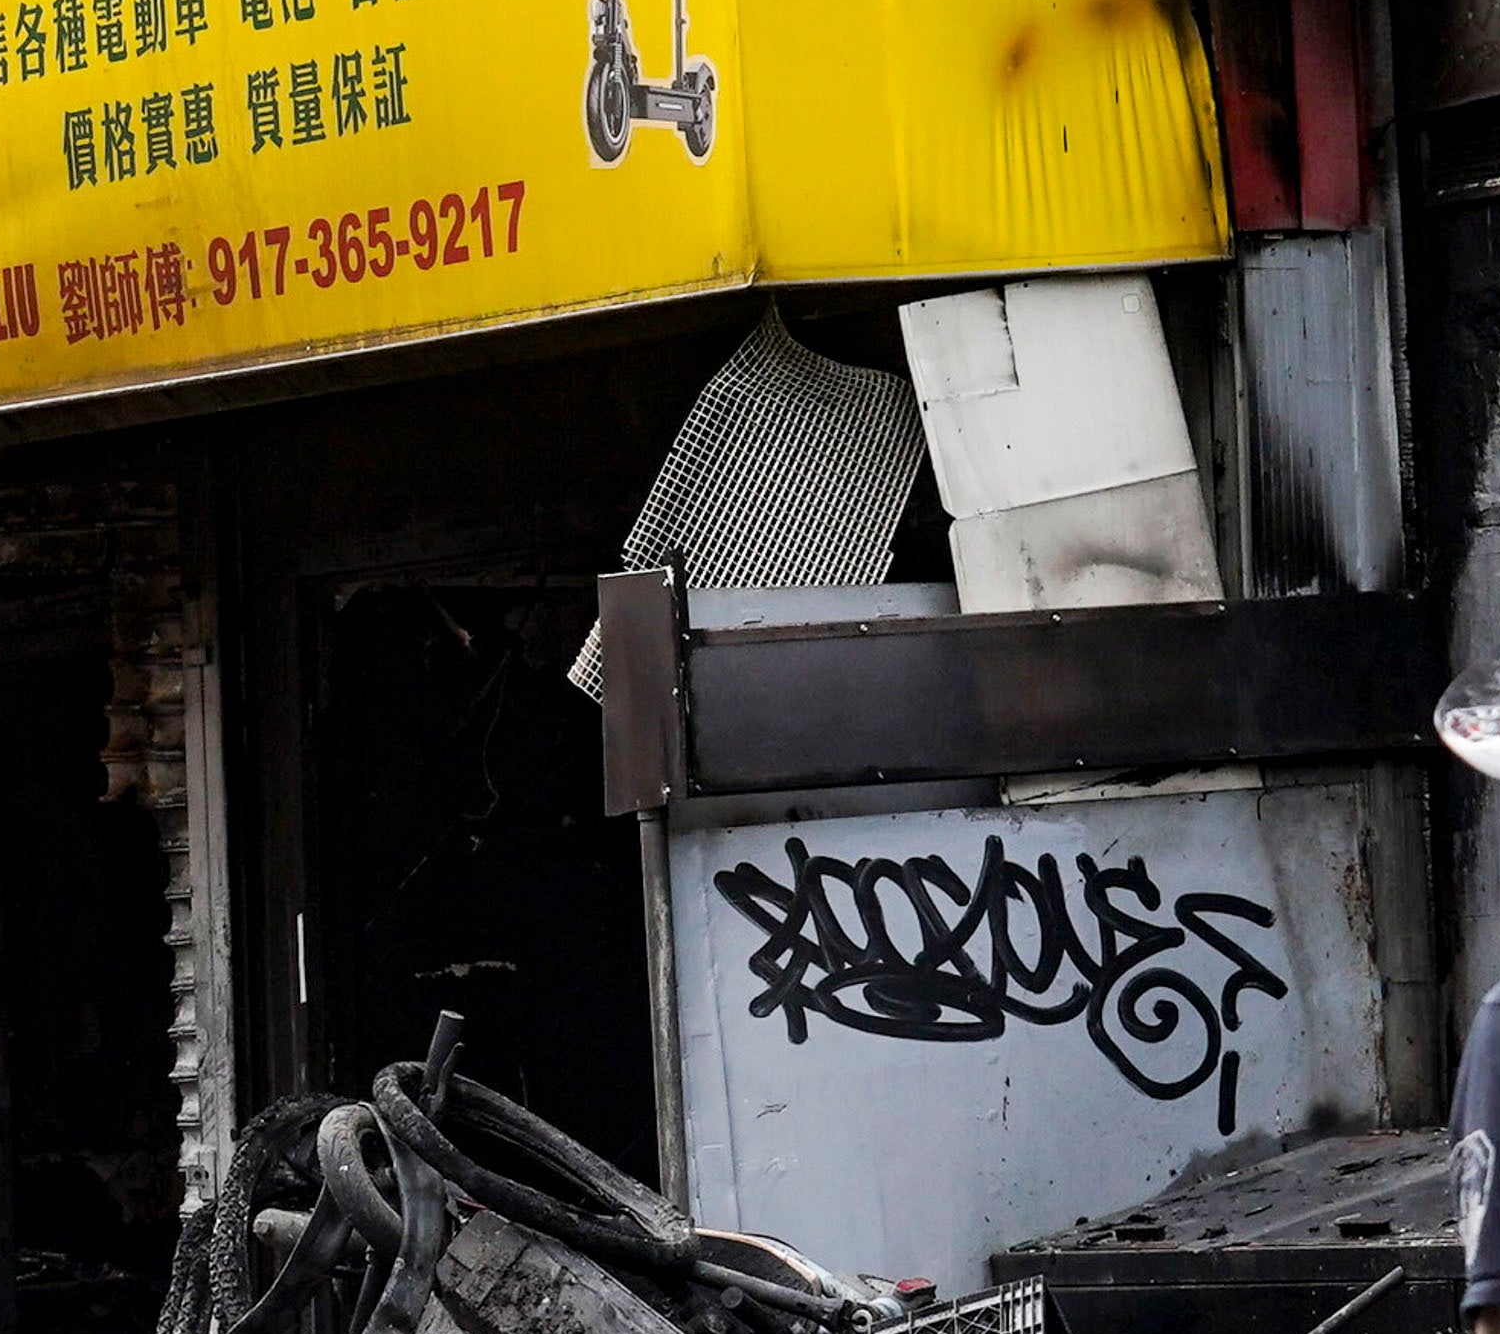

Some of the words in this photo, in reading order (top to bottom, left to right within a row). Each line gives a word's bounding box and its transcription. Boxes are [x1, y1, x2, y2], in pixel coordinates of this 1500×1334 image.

[63, 82, 220, 191] 價格實惠
[208, 180, 527, 307] 917-365-9217
